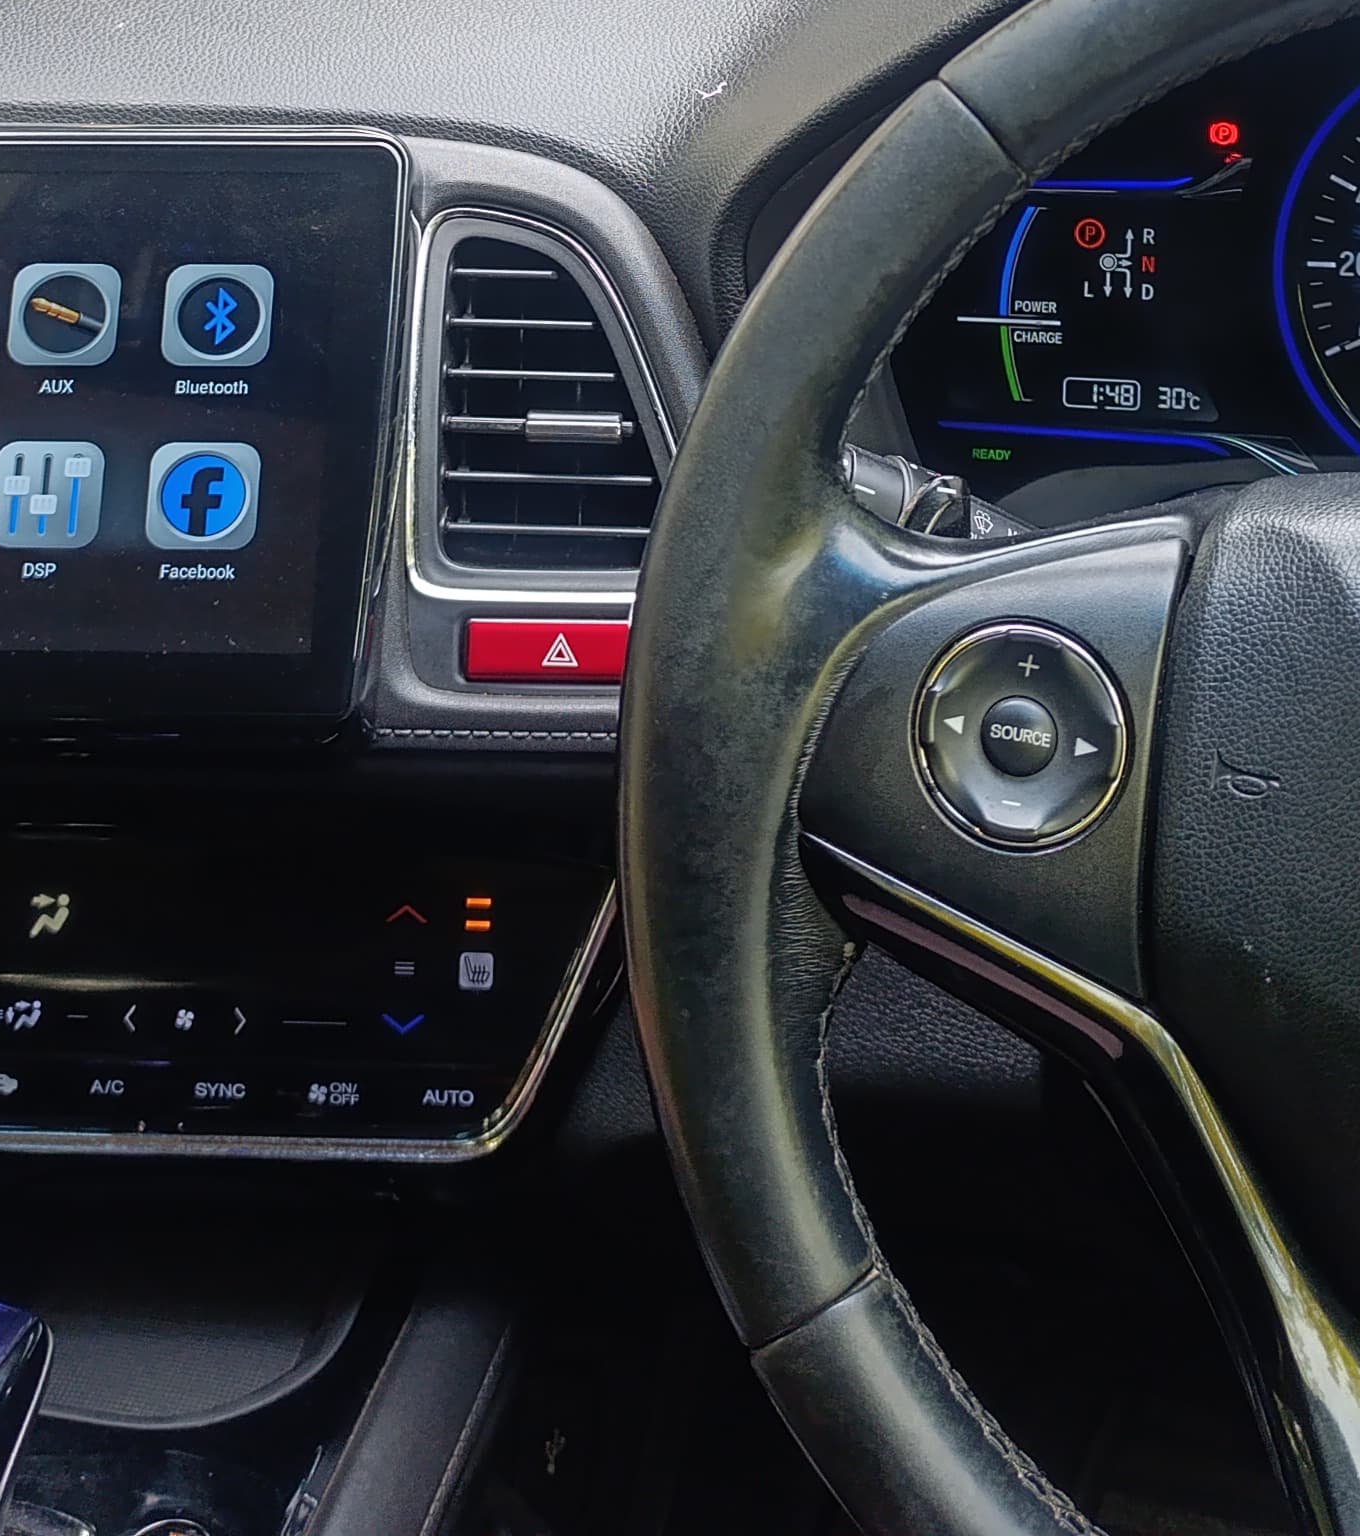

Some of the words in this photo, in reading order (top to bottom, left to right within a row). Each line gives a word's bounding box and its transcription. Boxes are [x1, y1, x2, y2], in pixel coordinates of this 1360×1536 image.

[1143, 228, 1155, 244] R
[1142, 256, 1155, 273] N
[1084, 282, 1094, 298] L
[1142, 284, 1154, 300] D
[1014, 300, 1057, 314] POWER
[1013, 330, 1063, 345] CHARGE
[39, 379, 74, 394] AUX
[175, 379, 249, 395] Bluetooth
[1092, 384, 1135, 407] 1:48
[972, 448, 1012, 461] READY
[22, 563, 56, 579] DSP
[159, 564, 235, 581] Facebook
[990, 723, 1051, 748] SOURCE
[90, 1079, 125, 1095] A/C
[194, 1082, 246, 1099] SYNC
[330, 1093, 359, 1105] OFF
[422, 1089, 474, 1106] AUTO
